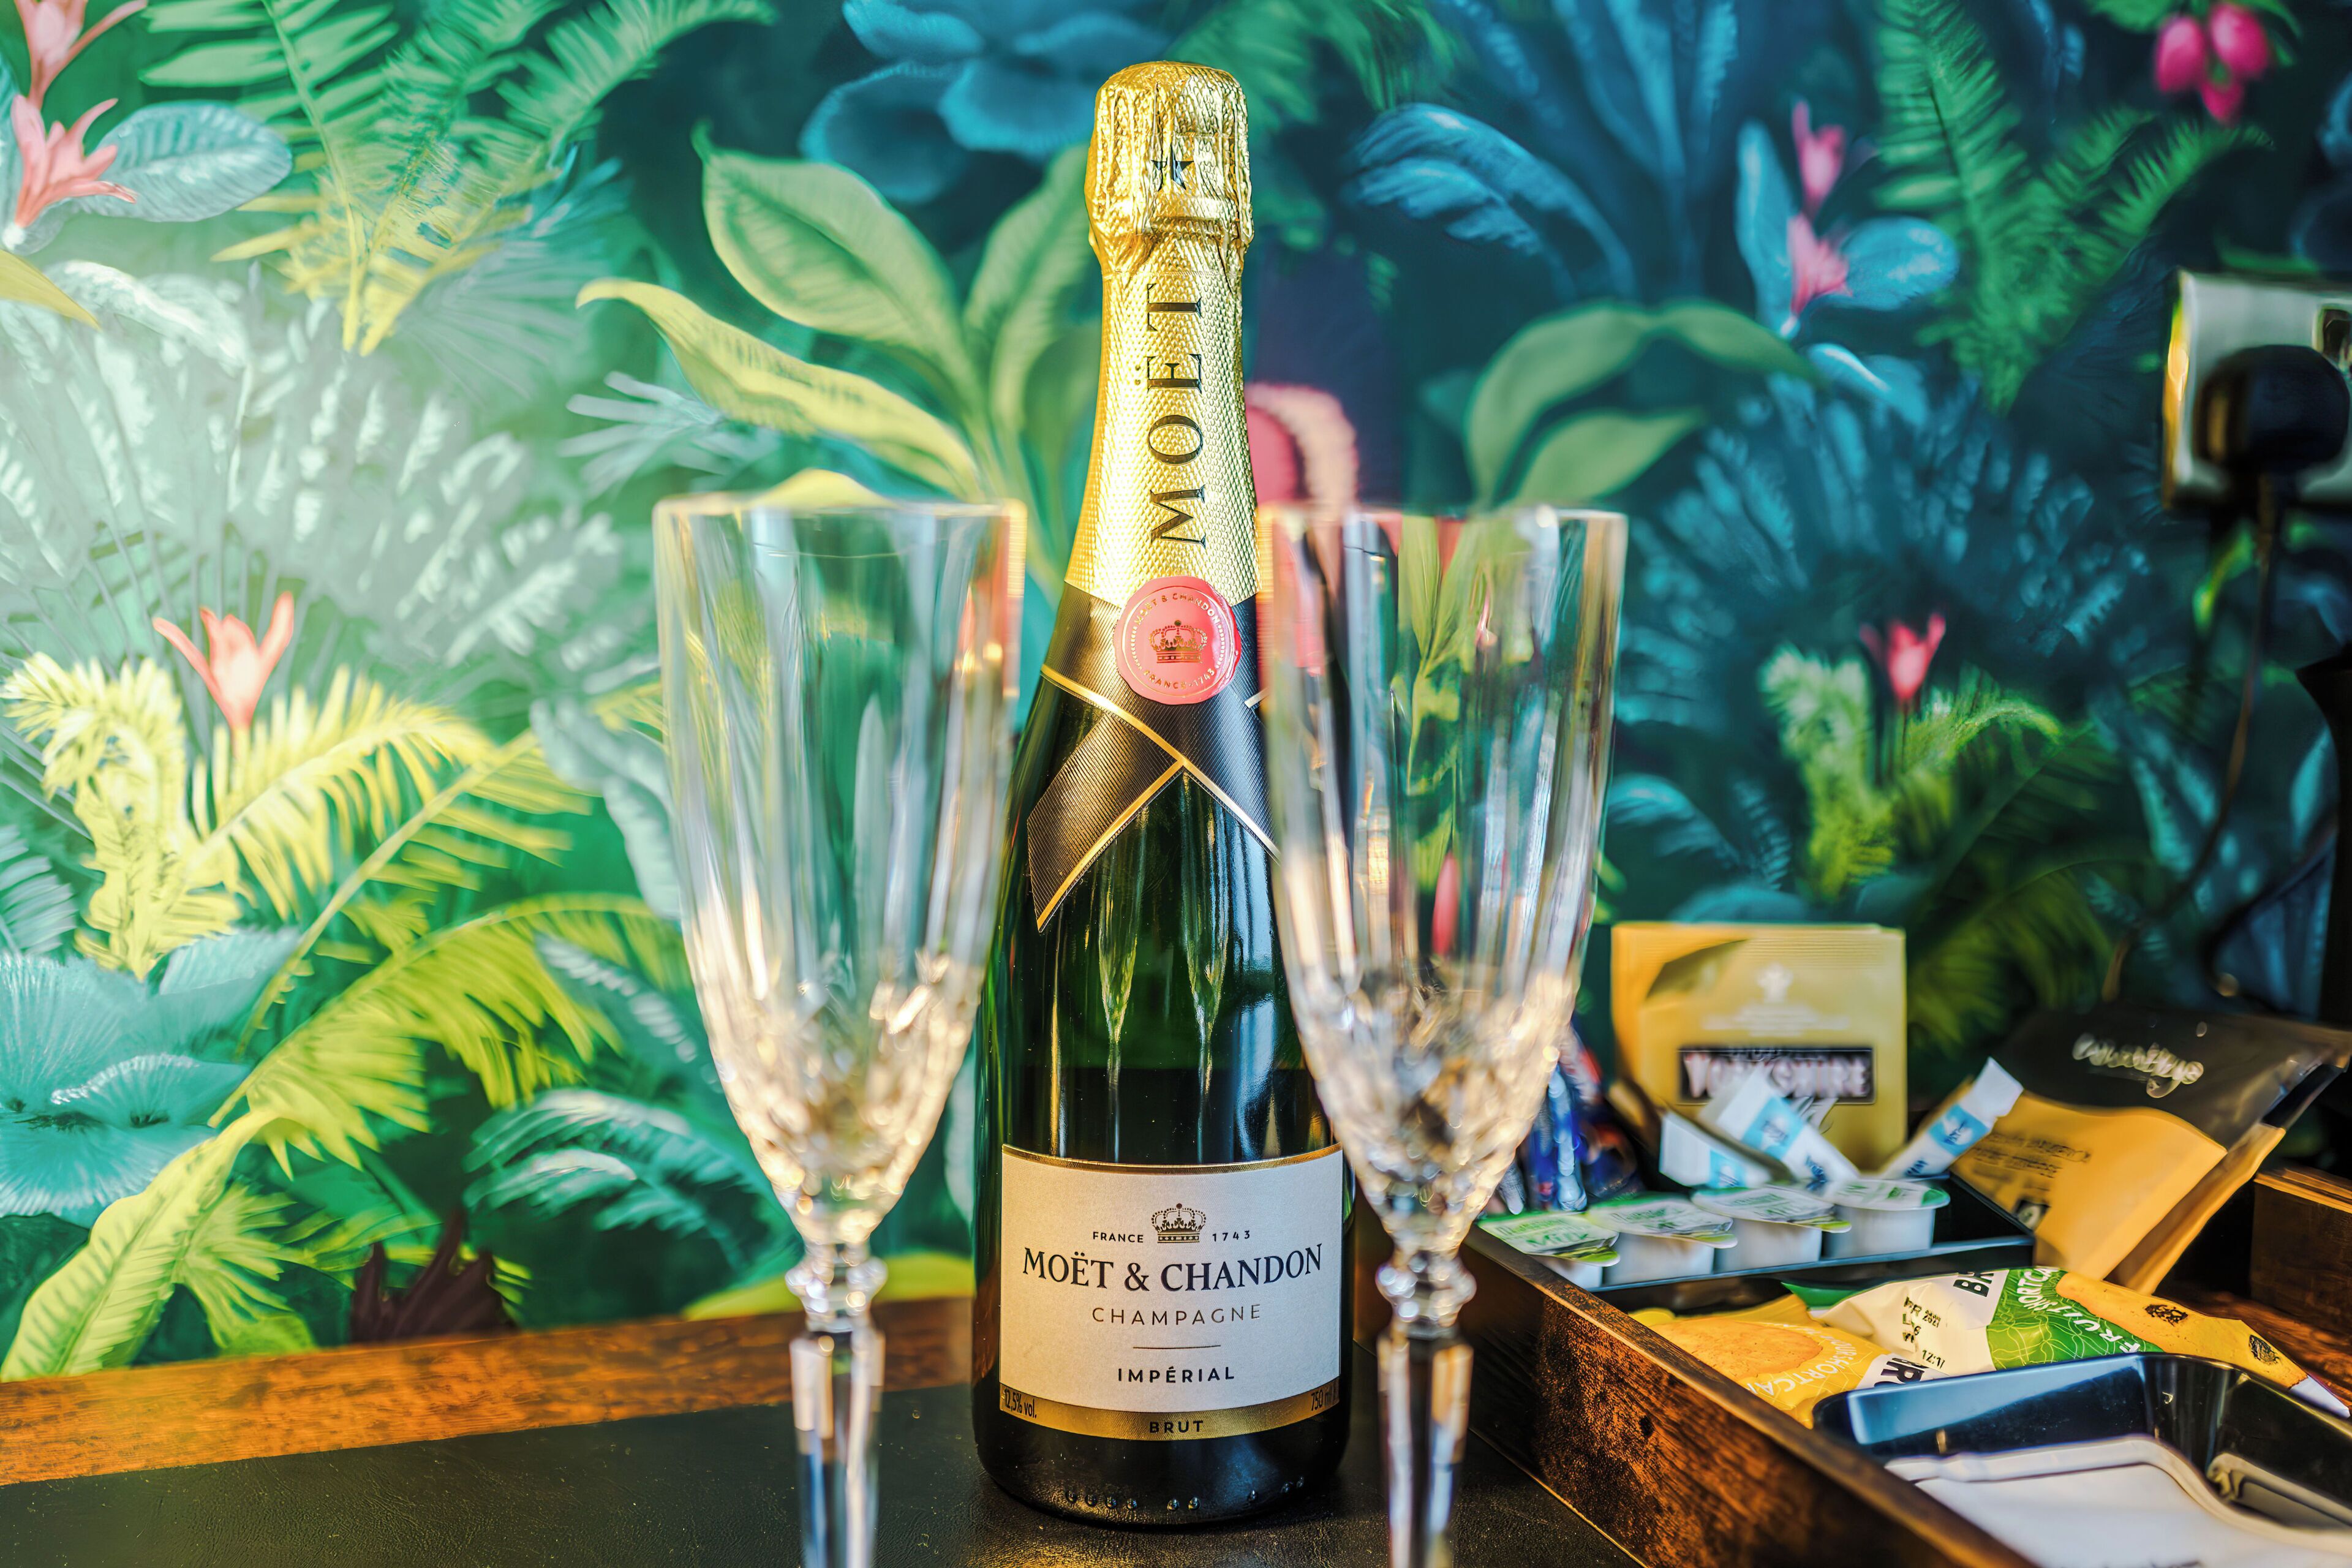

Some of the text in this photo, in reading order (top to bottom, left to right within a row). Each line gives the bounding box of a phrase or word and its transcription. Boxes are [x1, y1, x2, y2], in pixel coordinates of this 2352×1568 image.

[1135, 283, 1206, 549] MOËT
[1172, 593, 1221, 624] CHANDON
[1193, 668, 1215, 687] 1743
[1092, 1230, 1251, 1244] FRANCE 1743
[1022, 1243, 1323, 1292] MOËT & CHANDON
[1091, 1303, 1261, 1325] CHAMPAGNE
[1117, 1366, 1235, 1384] IMPÉRIAL
[1024, 1398, 1037, 1419] vol.
[1149, 1420, 1204, 1434] BRUT
